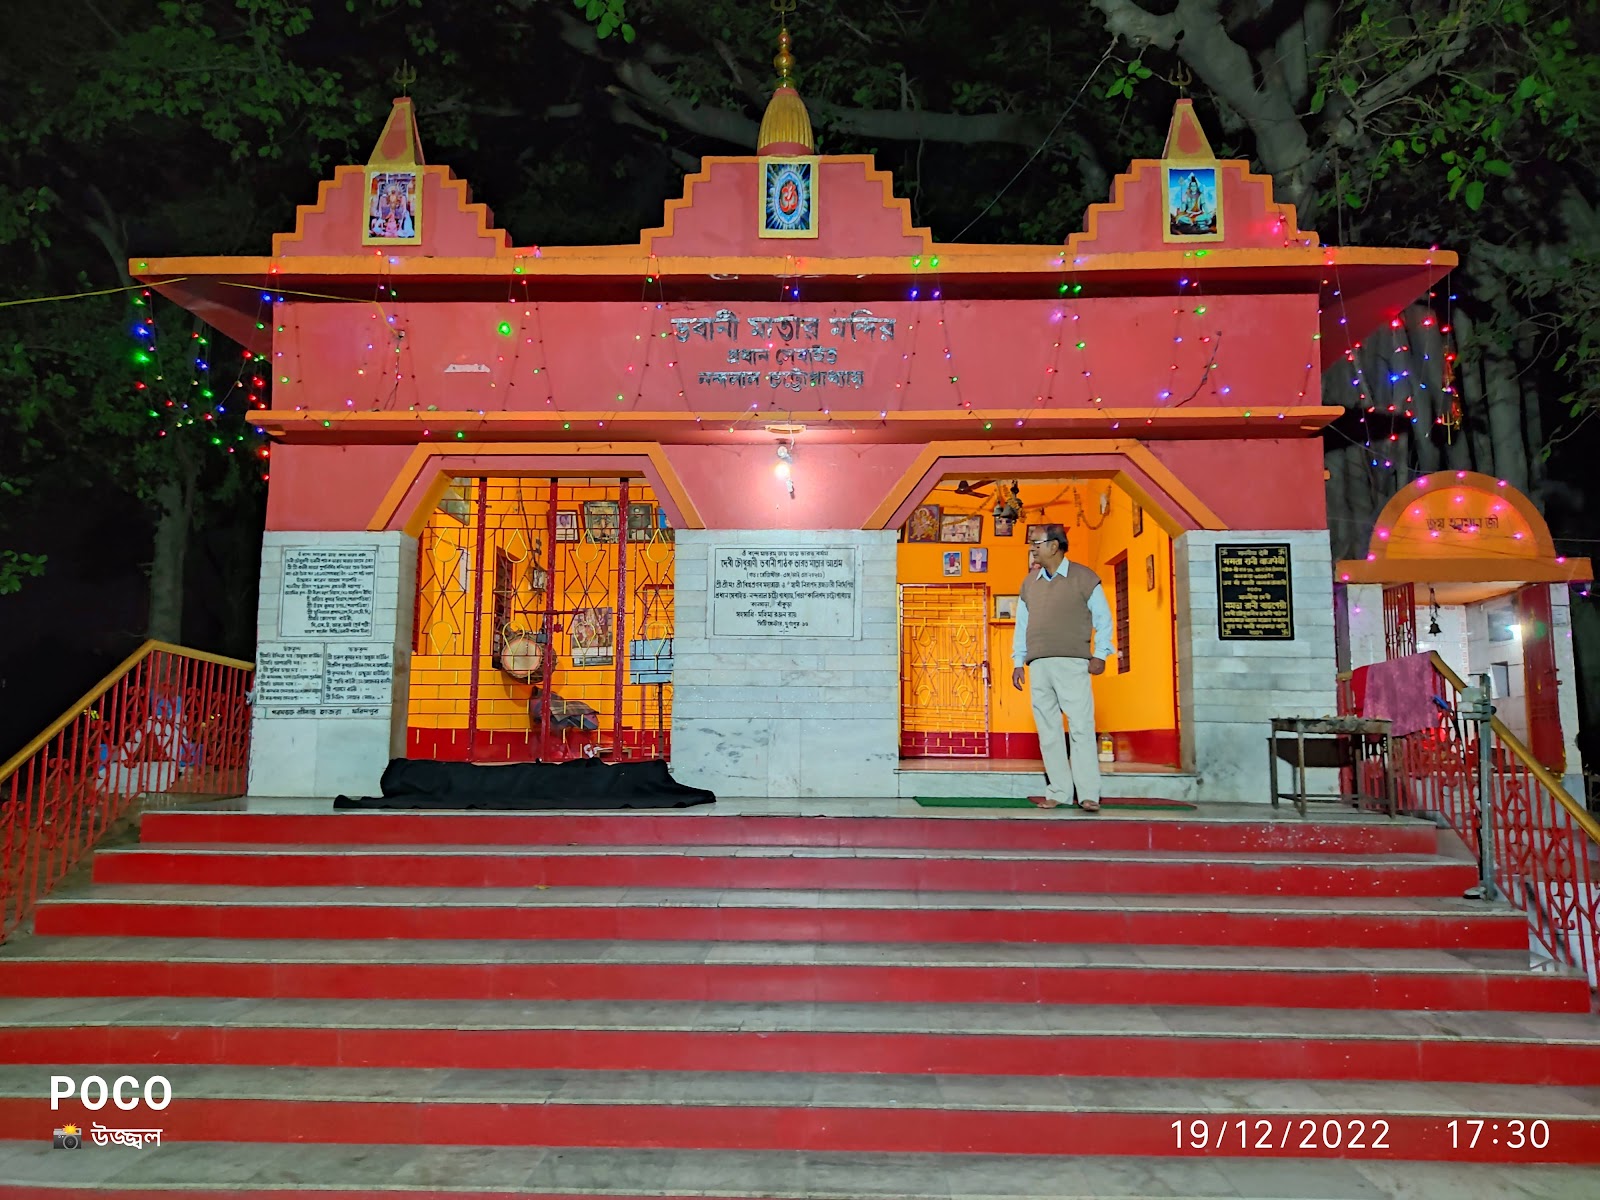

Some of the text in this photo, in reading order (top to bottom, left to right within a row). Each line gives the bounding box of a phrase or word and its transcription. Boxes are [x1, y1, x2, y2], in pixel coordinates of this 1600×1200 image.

[670, 309, 896, 343] ভবানী মাতার মন্দির
[720, 556, 734, 568] দেবী
